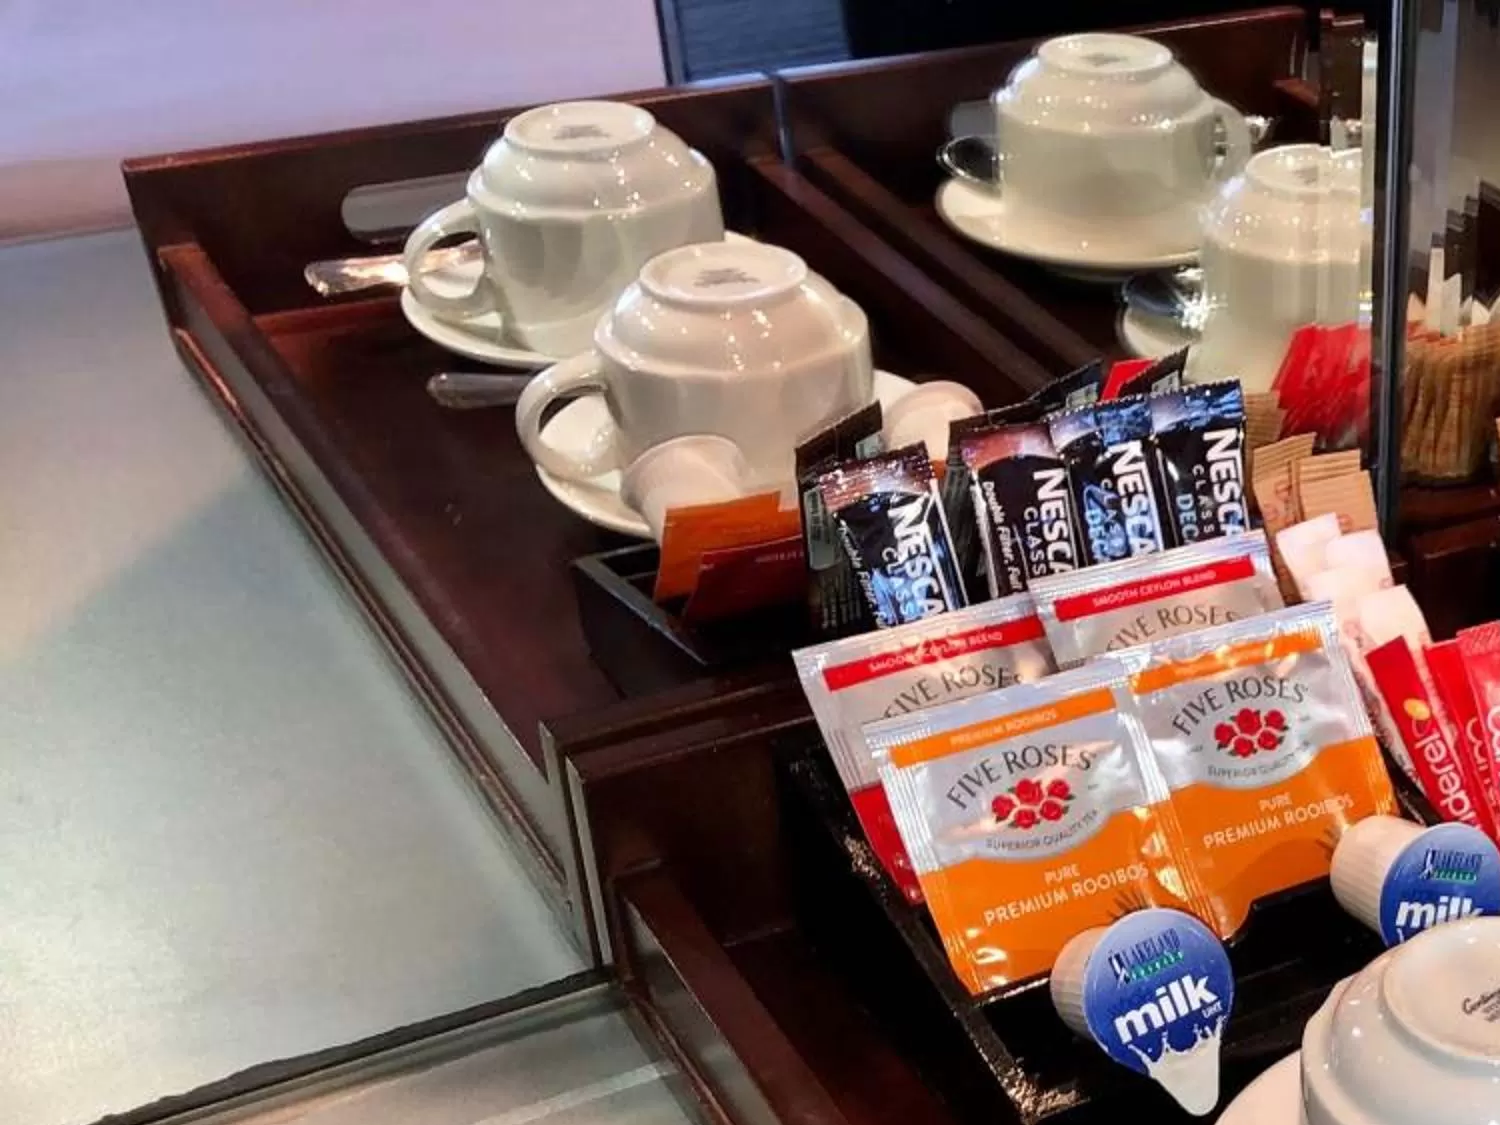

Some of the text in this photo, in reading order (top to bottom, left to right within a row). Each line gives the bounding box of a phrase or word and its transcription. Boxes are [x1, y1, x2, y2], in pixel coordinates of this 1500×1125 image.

[1172, 674, 1306, 737] FIVE ROSES
[946, 742, 1093, 811] FIVE ROSES
[1203, 815, 1283, 850] PREMIUM
[983, 864, 1149, 927] PREMIUM ROOIBOS
[1043, 863, 1081, 885] PURE
[1113, 974, 1218, 1045] milk
